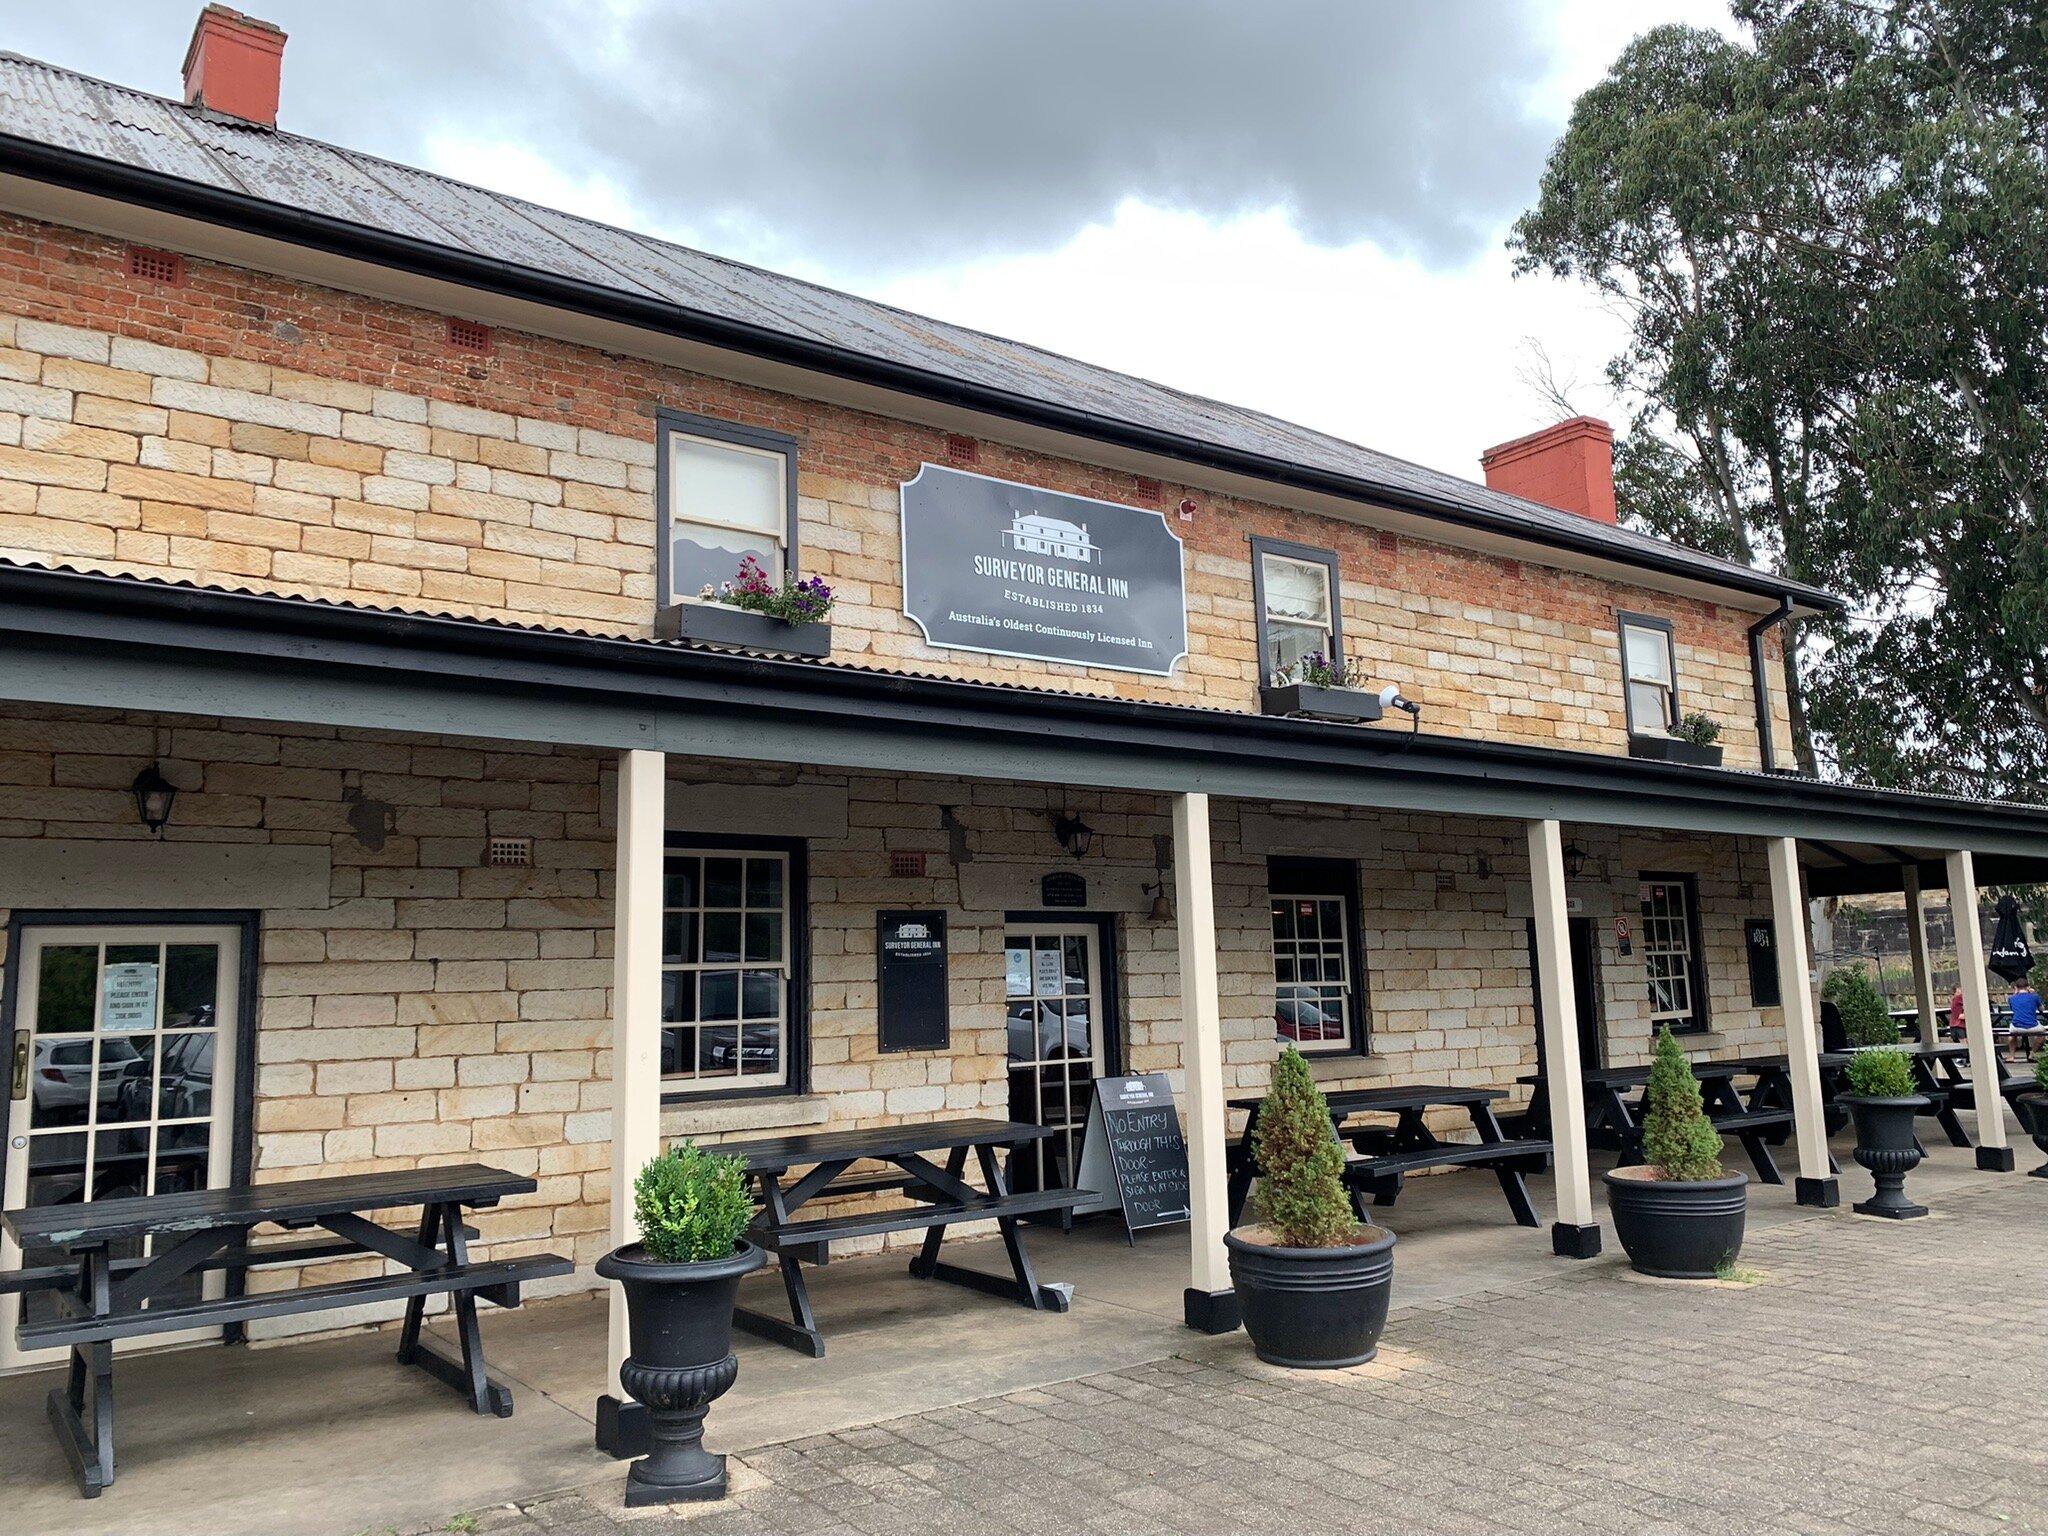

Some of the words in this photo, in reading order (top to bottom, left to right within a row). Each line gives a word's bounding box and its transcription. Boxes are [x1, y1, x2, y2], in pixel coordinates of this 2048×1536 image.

[973, 555, 1045, 586] SURVEYOR
[1047, 567, 1105, 595] GENERAL
[1107, 577, 1129, 599] INN
[1004, 589, 1078, 613] ESTABLISHED
[1081, 603, 1104, 614] 1834
[949, 610, 1001, 627] Australia's
[1003, 618, 1033, 632] Oldest
[1035, 624, 1095, 642] Continuously
[1097, 632, 1136, 647] Licensed
[1138, 638, 1153, 648] Inn
[884, 941, 910, 949] SURVEYOR
[911, 941, 932, 949] GENERAL
[1107, 1112, 1127, 1134] NO
[1126, 1111, 1167, 1133] ENTRY
[1113, 1137, 1152, 1153] THROUGH
[1154, 1134, 1180, 1150] THIS
[1118, 1156, 1147, 1171] DOOR
[1120, 1171, 1150, 1185] PLEASE
[1152, 1168, 1177, 1181] ENTER
[1125, 1185, 1146, 1198] SIGN
[1148, 1184, 1157, 1194] IN
[1158, 1183, 1167, 1193] AT
[1134, 1199, 1161, 1213] DOOR
